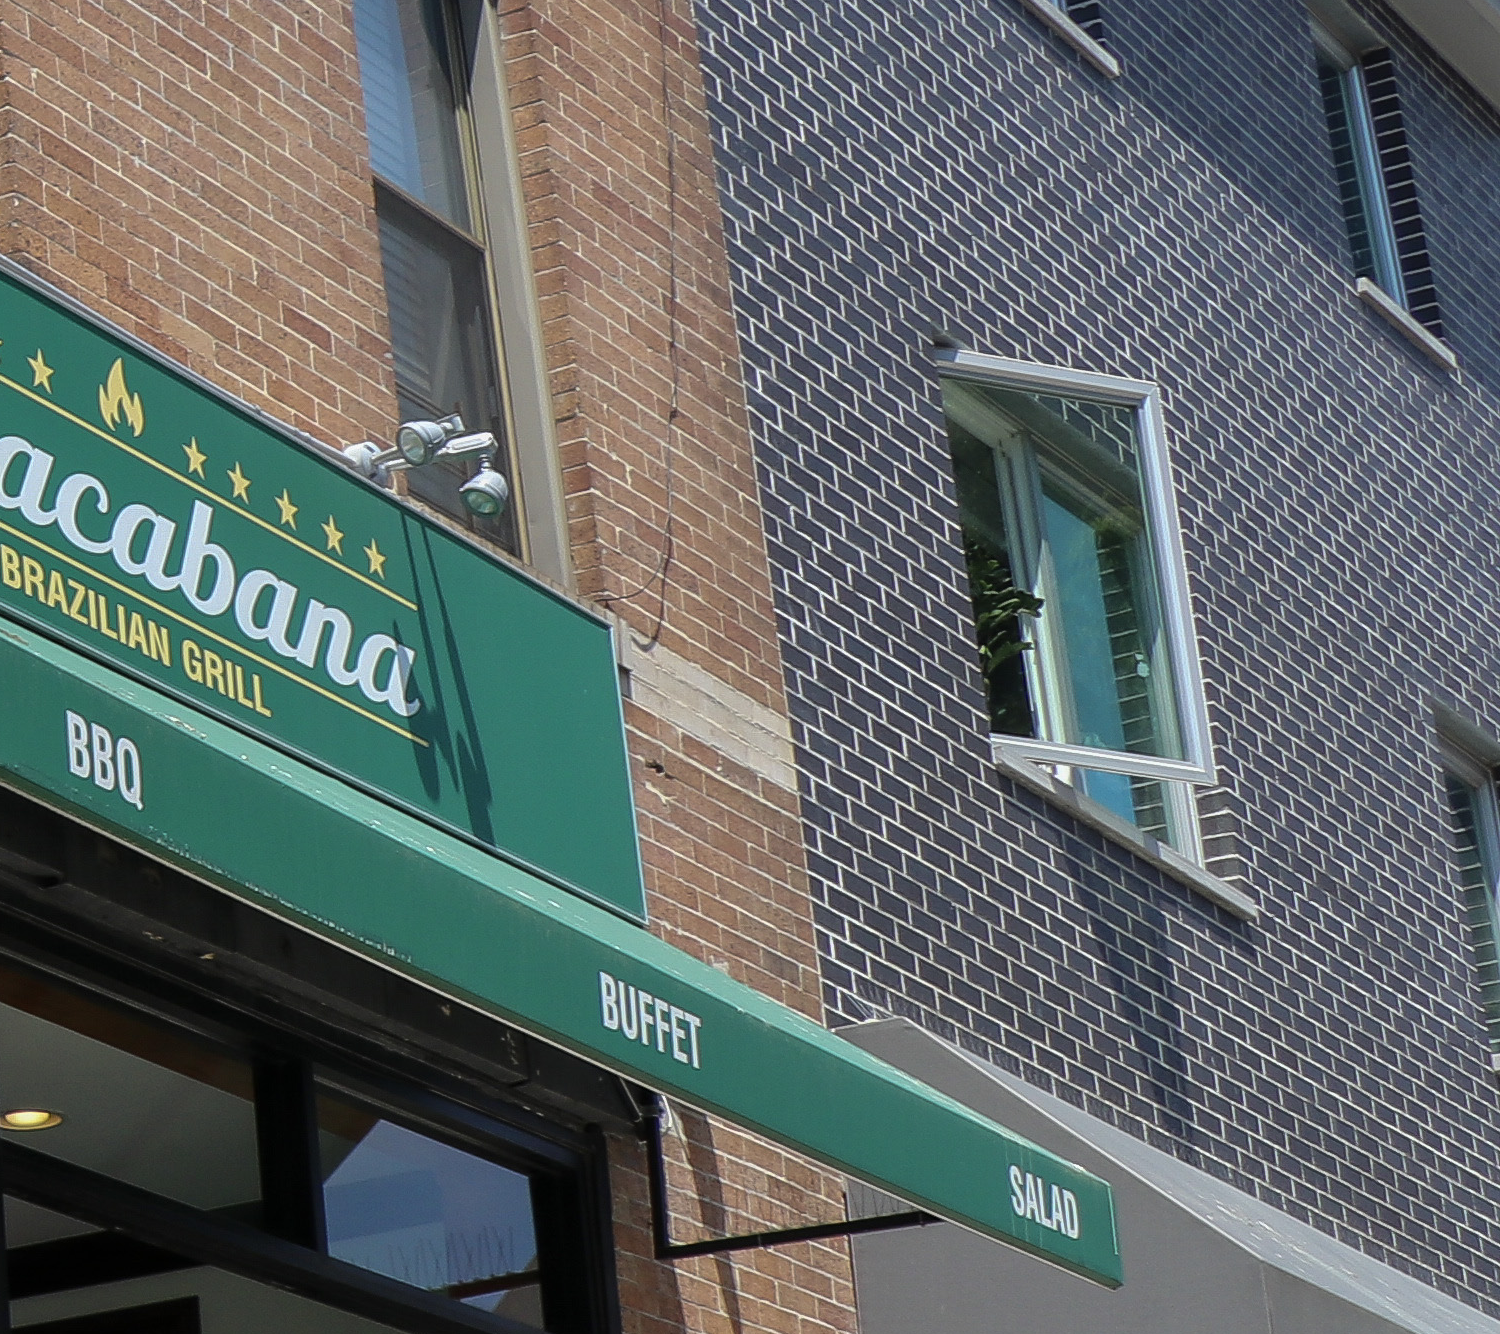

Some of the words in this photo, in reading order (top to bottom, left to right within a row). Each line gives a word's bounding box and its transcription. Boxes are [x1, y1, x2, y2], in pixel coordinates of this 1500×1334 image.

[0, 543, 172, 668] BRAZILIAN
[181, 638, 272, 719] GRILL
[65, 709, 145, 811] BBQ
[598, 970, 703, 1070] BUFFET
[1008, 1164, 1080, 1240] SALAD
